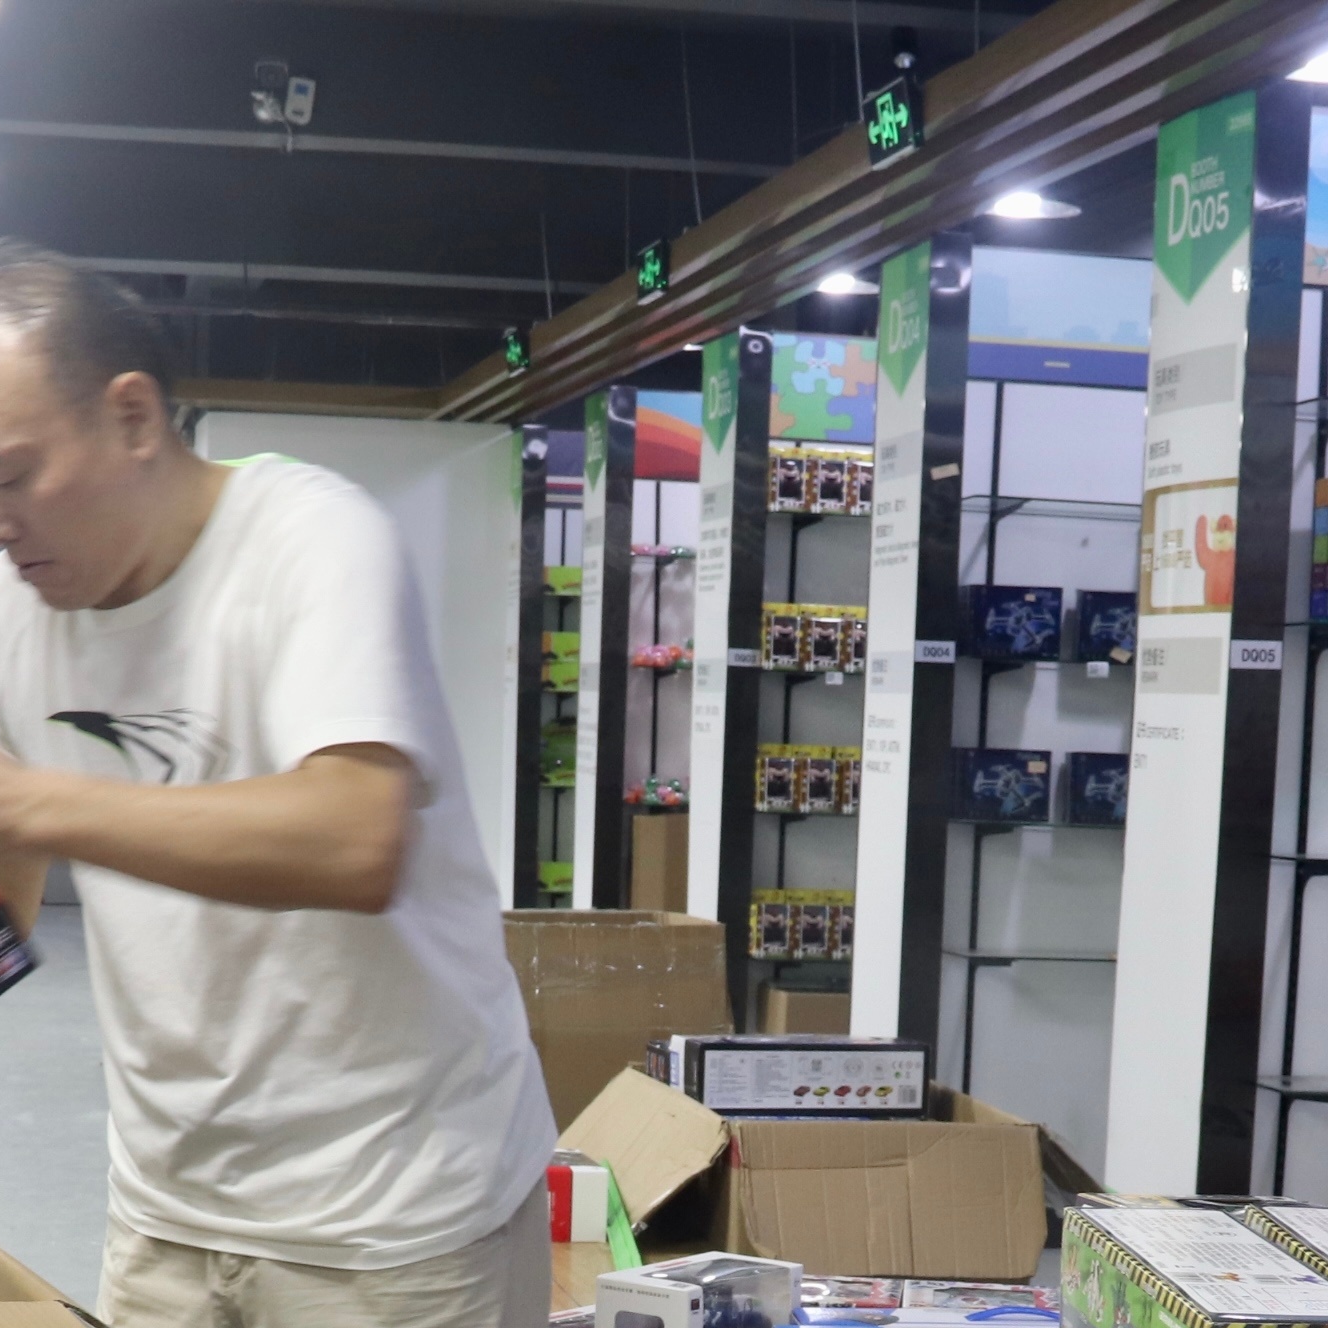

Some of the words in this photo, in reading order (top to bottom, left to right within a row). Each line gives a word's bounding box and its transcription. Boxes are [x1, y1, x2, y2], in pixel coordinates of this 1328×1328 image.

[1168, 173, 1230, 247] DQ05
[923, 646, 951, 657] DQ04
[1242, 648, 1276, 663] DQ05
